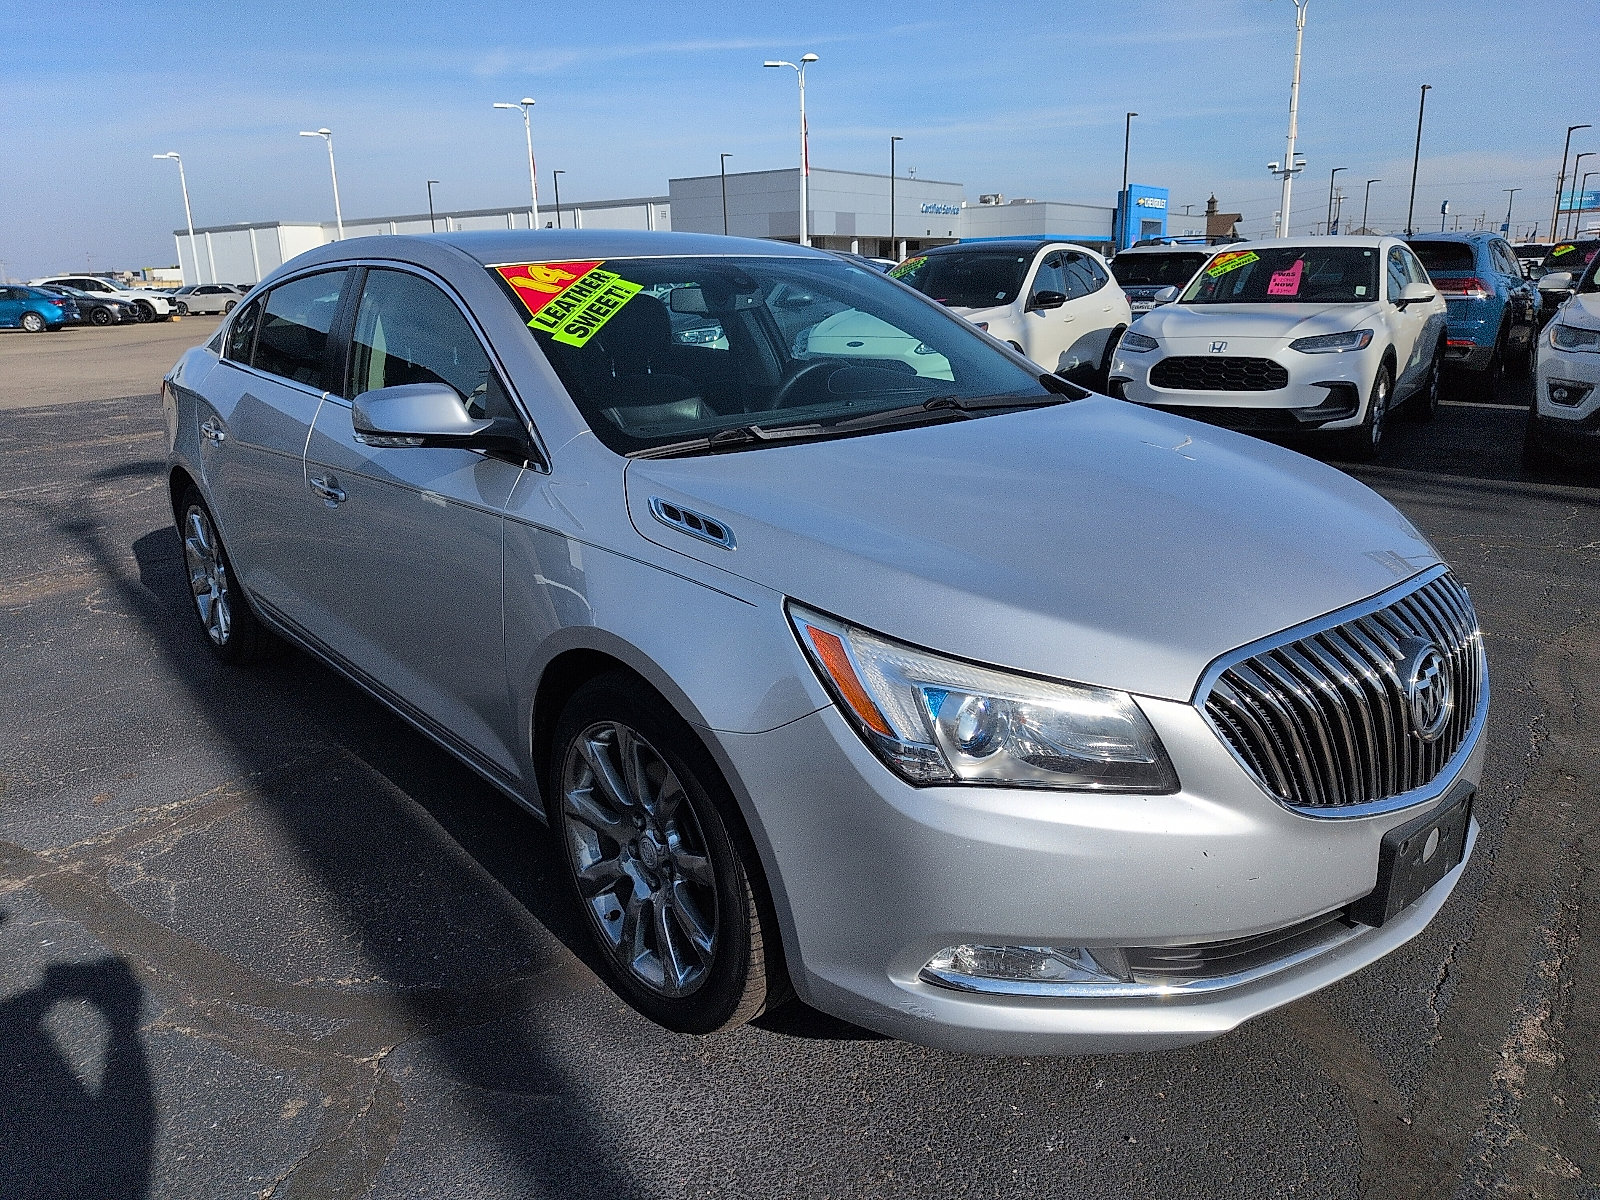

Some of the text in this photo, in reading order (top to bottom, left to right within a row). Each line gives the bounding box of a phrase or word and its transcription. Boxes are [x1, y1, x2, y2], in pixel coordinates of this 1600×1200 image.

[921, 203, 959, 215] Certified Service
[508, 265, 577, 293] 14
[1213, 267, 1228, 277] ONE
[1230, 256, 1257, 269] OWNER
[535, 271, 612, 328] LEATHER
[563, 284, 633, 338] SWEET!
